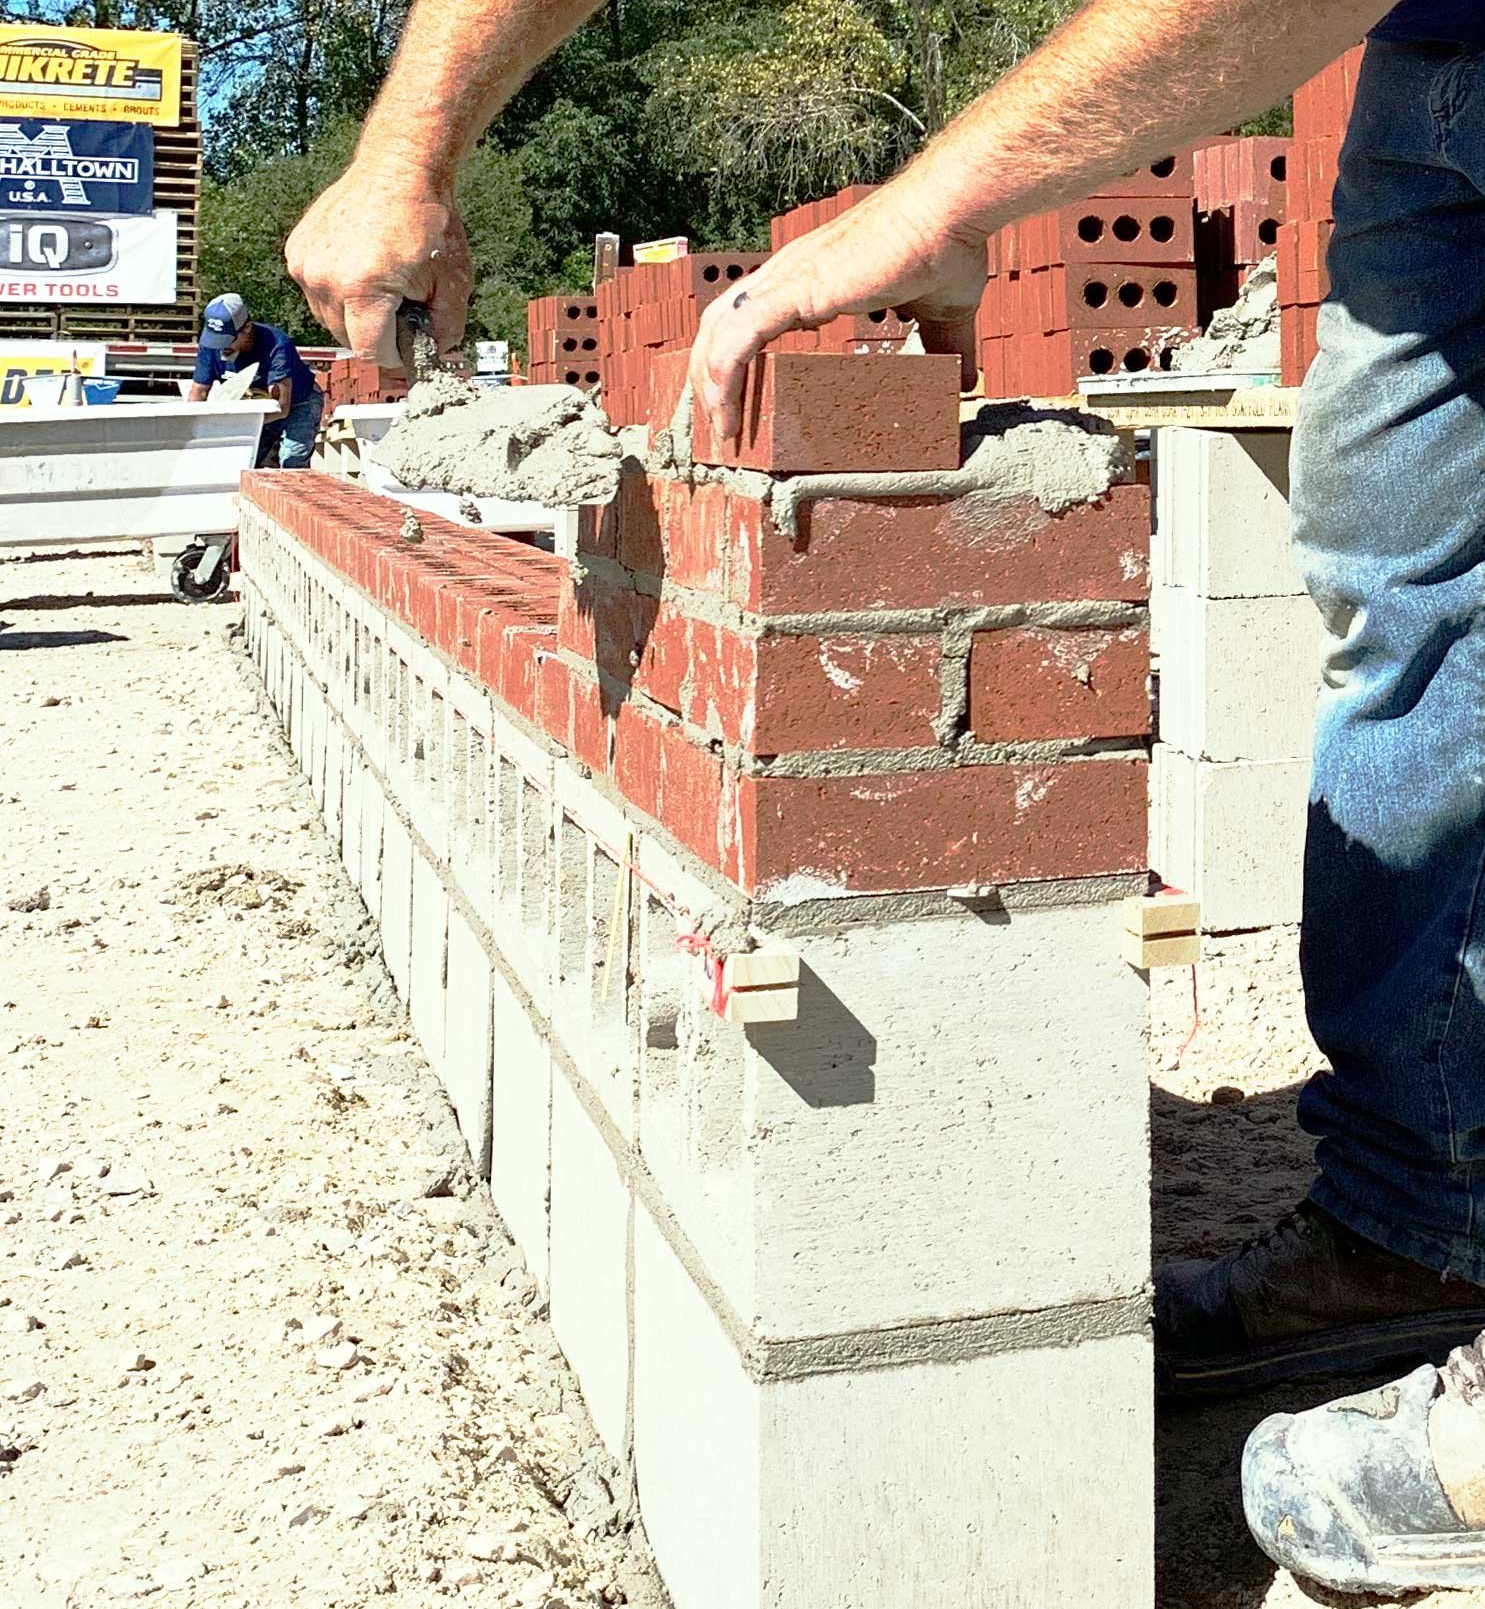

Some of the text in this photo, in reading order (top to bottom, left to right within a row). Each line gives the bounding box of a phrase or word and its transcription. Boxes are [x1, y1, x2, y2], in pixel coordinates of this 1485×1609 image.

[71, 49, 117, 60] GRADE
[63, 103, 107, 113] CEMENTS
[45, 284, 119, 297] TOOLS
